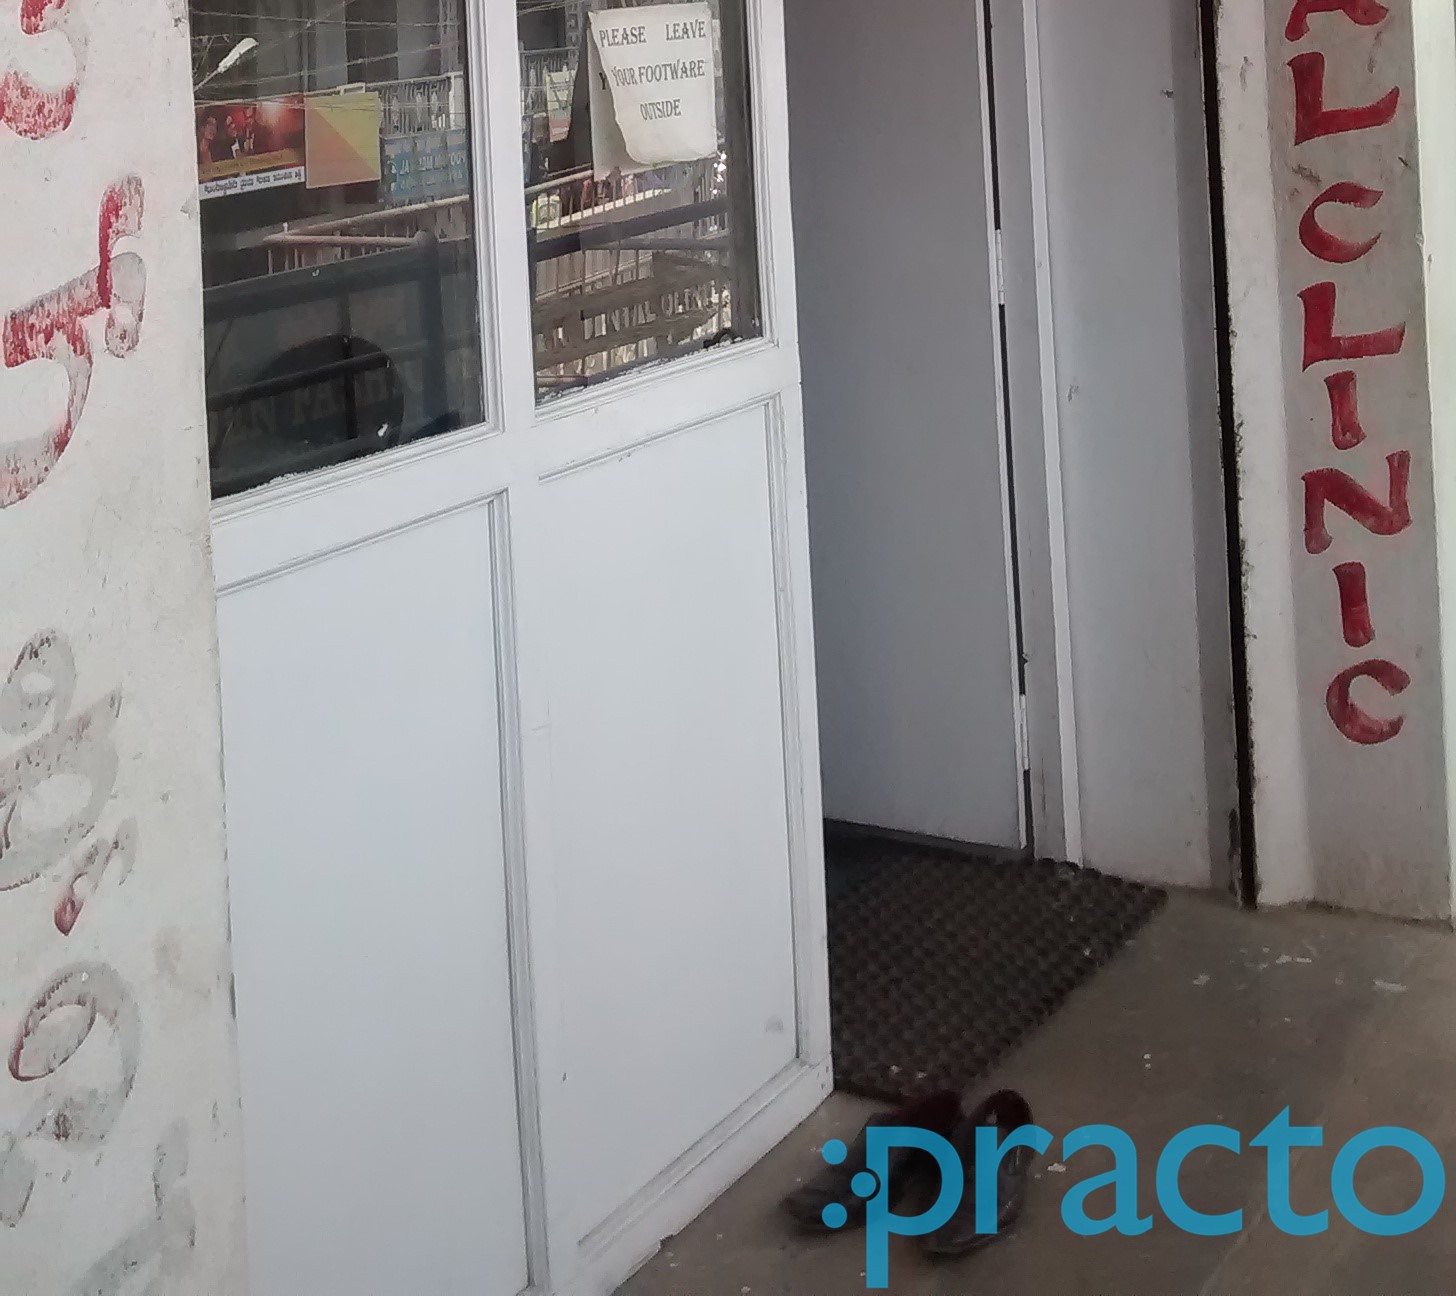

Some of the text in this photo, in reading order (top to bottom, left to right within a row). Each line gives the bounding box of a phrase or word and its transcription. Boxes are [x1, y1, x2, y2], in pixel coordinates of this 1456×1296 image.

[599, 18, 707, 48] PLEASE LEAVE
[611, 65, 638, 87] YOUR
[638, 58, 706, 84] FOOTWARE
[640, 98, 682, 121] OUTSIDE
[1297, 180, 1413, 746] CLINIC
